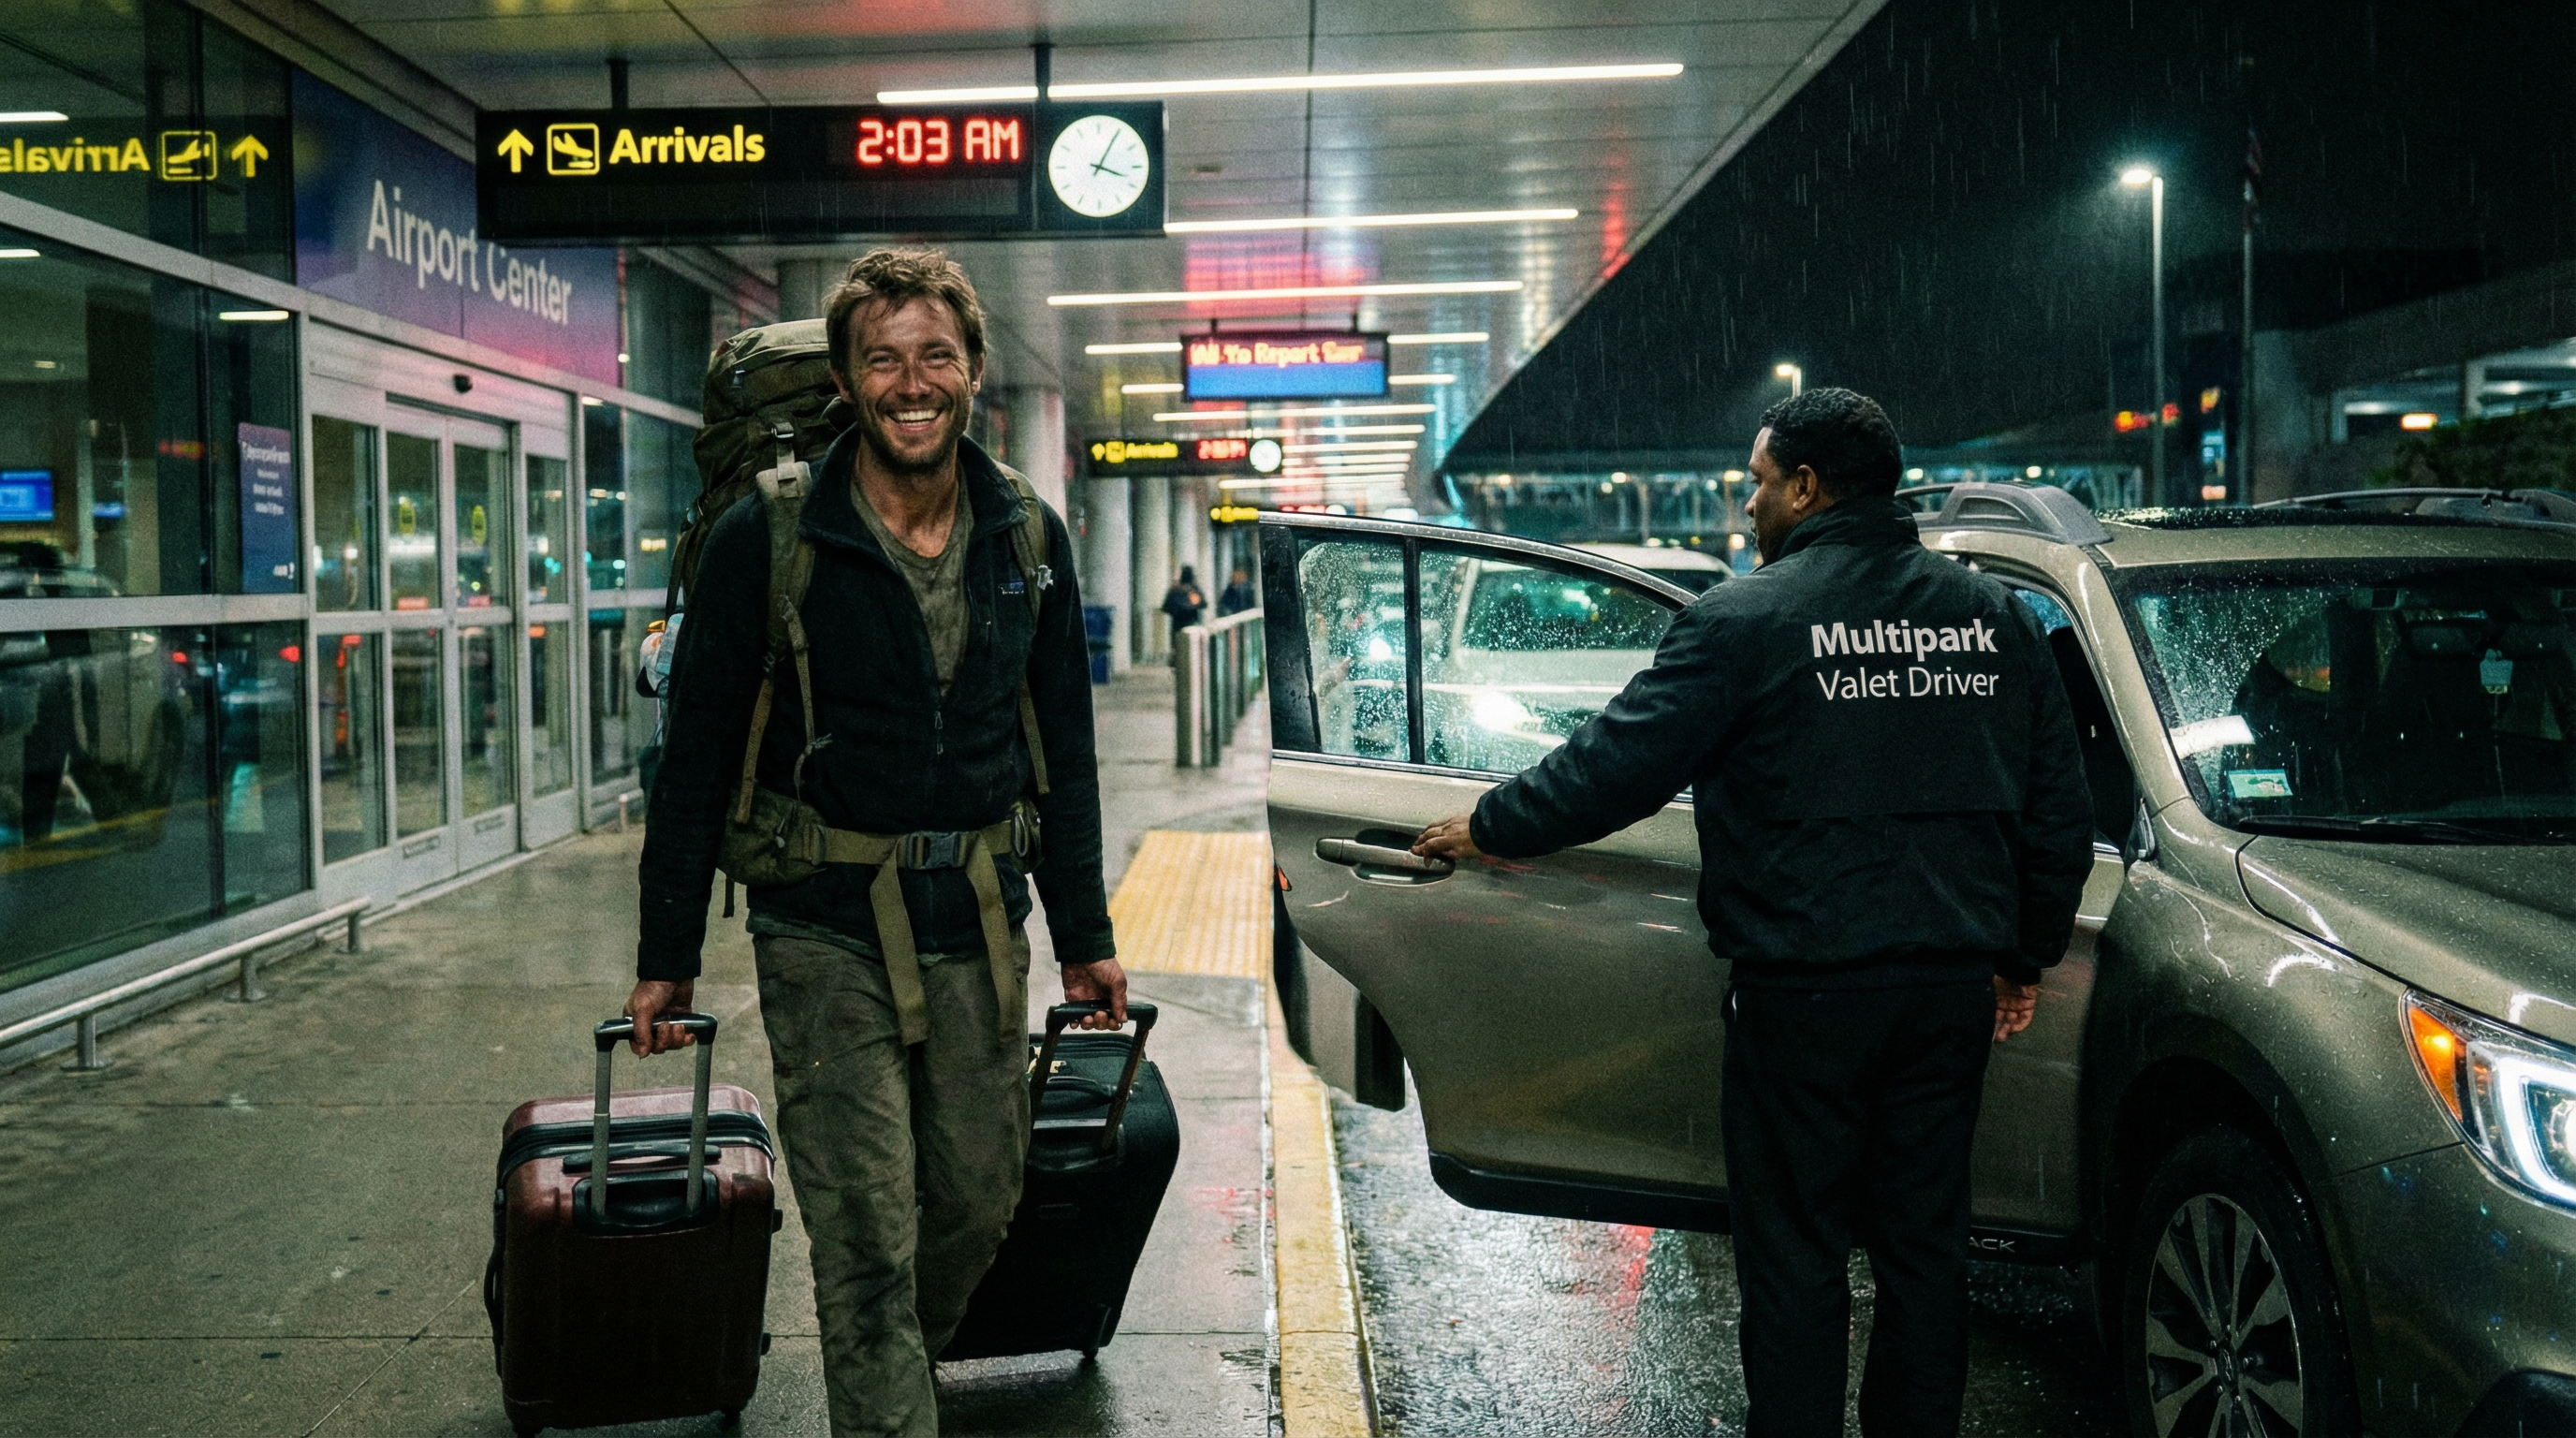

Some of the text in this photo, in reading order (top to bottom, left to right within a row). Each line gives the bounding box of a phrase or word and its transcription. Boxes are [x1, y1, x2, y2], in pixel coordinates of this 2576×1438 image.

[608, 125, 766, 165] Arrivals
[857, 118, 1020, 165] 2:03 AM
[367, 179, 572, 325] Airport Center
[1811, 618, 1999, 663] Multipark
[1816, 666, 1999, 701] Valet Driver
[1969, 1236, 2016, 1253] ACK
